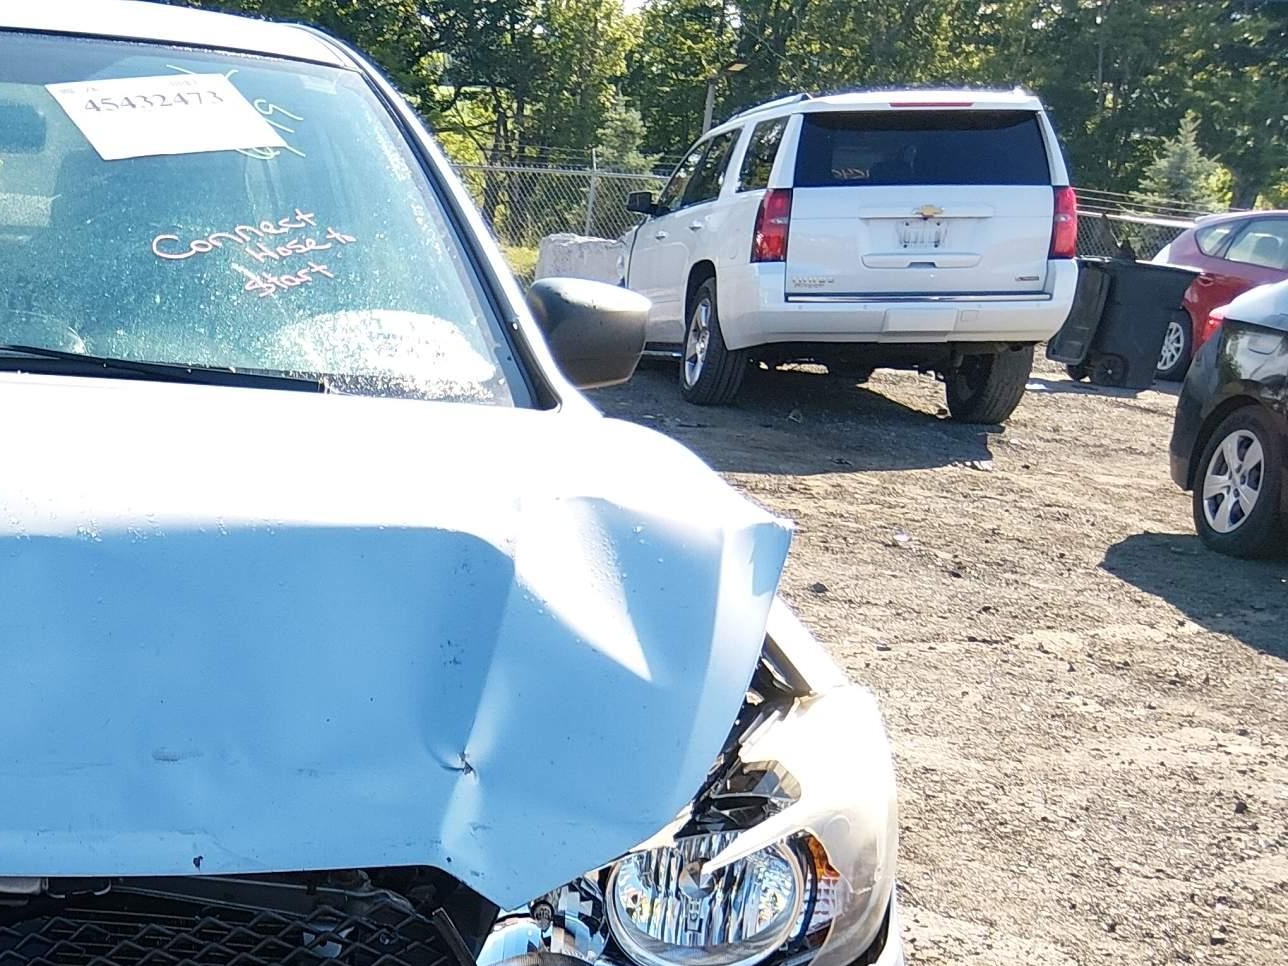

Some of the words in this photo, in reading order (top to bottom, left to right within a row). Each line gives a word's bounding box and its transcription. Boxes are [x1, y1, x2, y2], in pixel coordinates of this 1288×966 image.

[83, 90, 224, 113] 45432473
[152, 208, 317, 260] Connect
[246, 237, 331, 263] Hose
